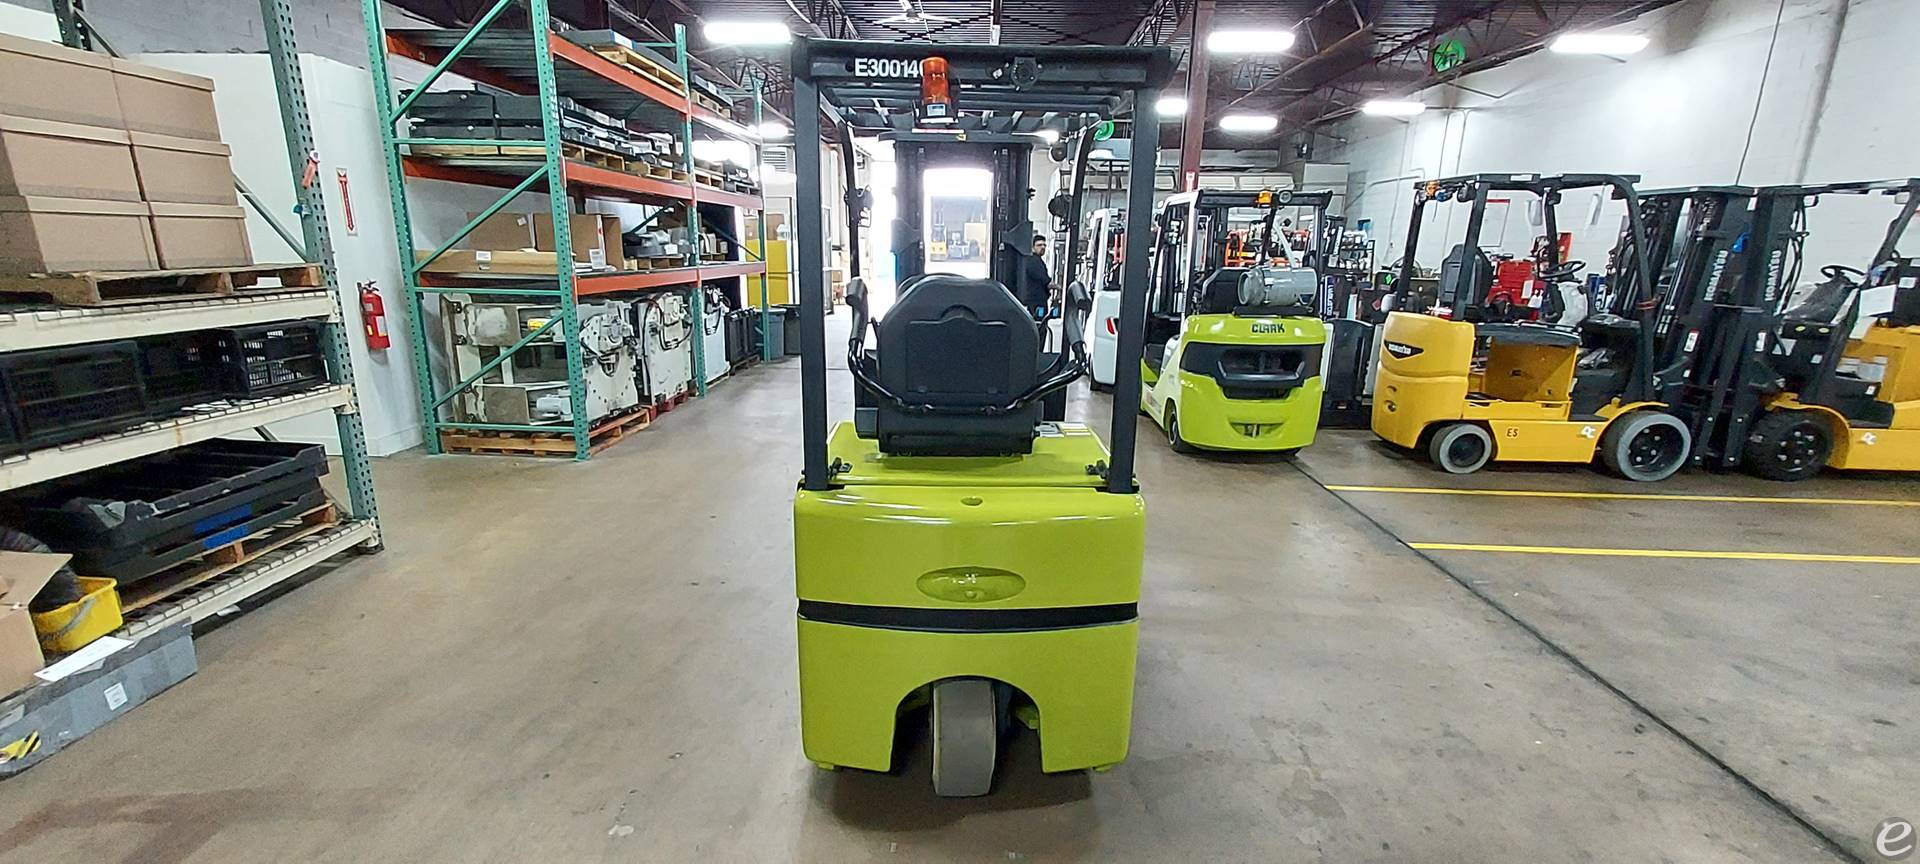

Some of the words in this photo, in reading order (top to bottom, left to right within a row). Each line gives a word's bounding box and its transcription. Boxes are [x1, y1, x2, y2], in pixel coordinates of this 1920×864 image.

[855, 58, 924, 78] E30014
[1703, 250, 1728, 301] KOMATSU
[1764, 250, 1781, 301] KOMATSU
[1252, 323, 1285, 333] CLARK
